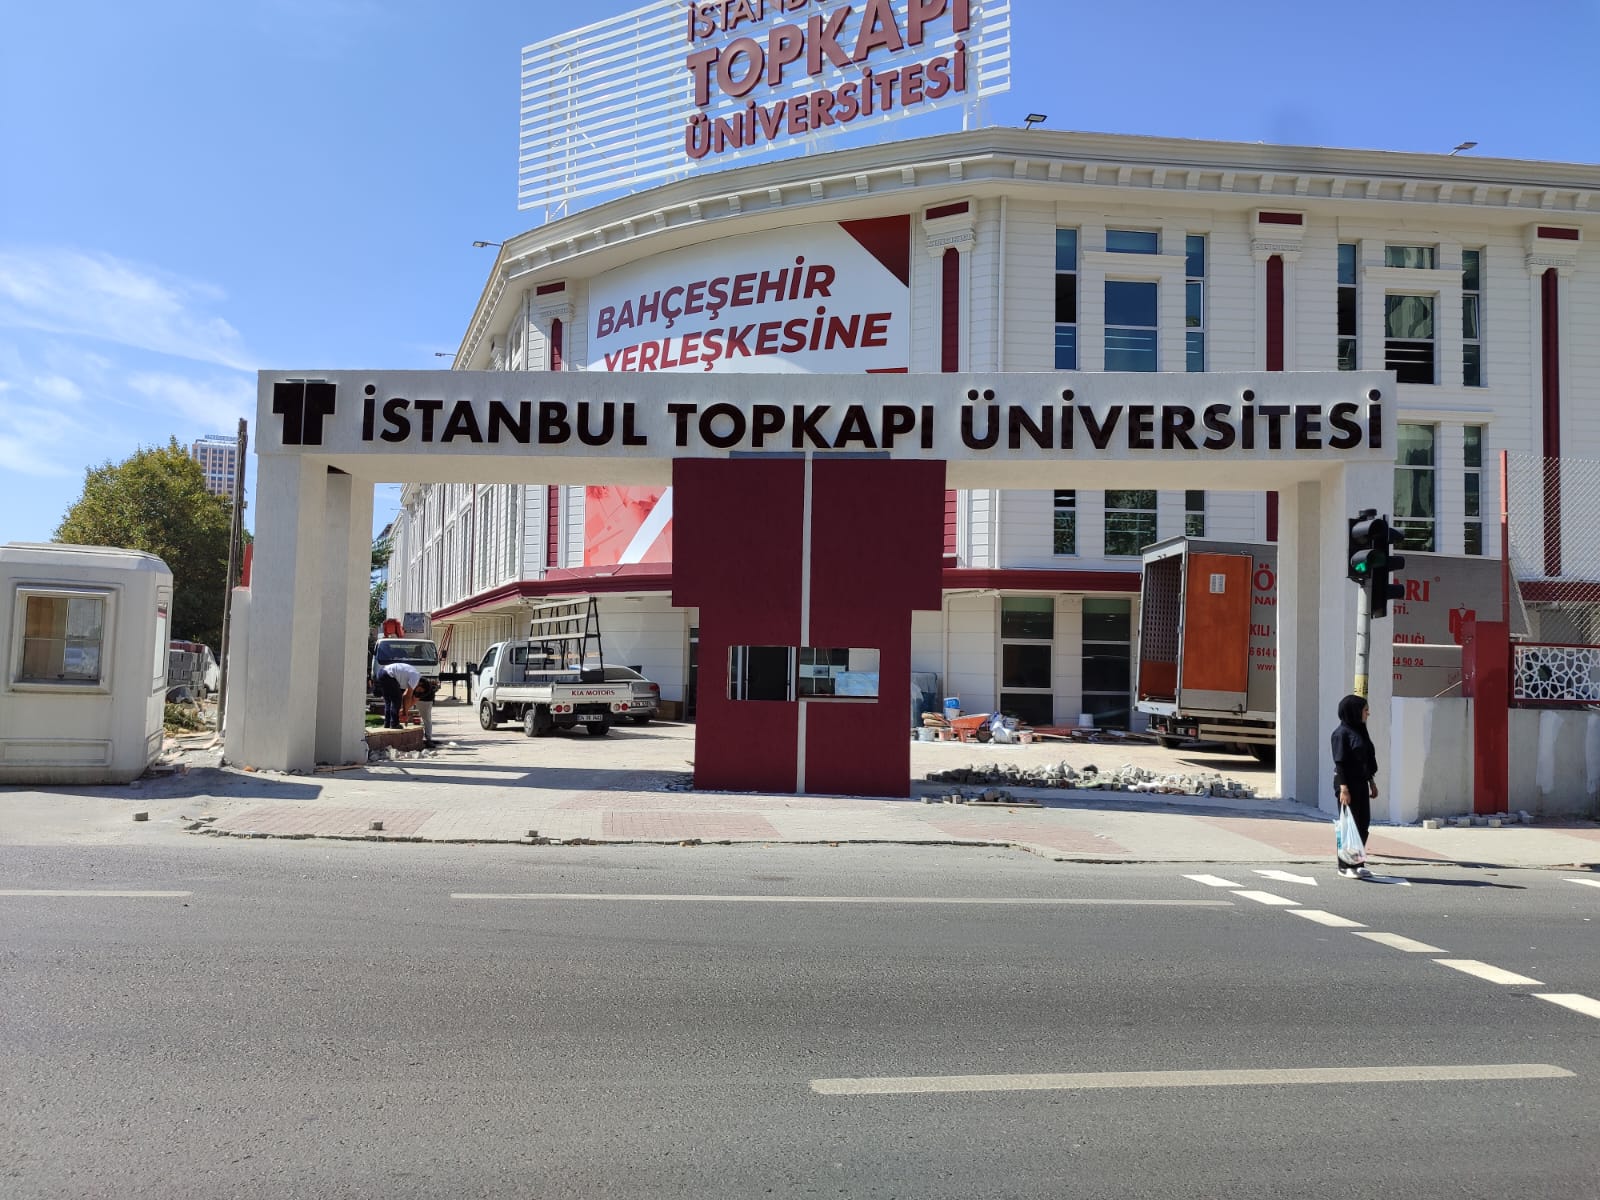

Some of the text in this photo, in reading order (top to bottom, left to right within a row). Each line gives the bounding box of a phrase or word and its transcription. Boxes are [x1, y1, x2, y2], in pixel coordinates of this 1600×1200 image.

[686, 0, 971, 107] TOPKAPI
[685, 40, 966, 160] ÜNİVERSİTESİ
[597, 256, 836, 340] BAHÇEŞEHİR
[604, 306, 892, 372] YERLEŞKESİNE
[362, 384, 1382, 450] İSTANBUL TOPKAPI ÜNİVERSİTESİ
